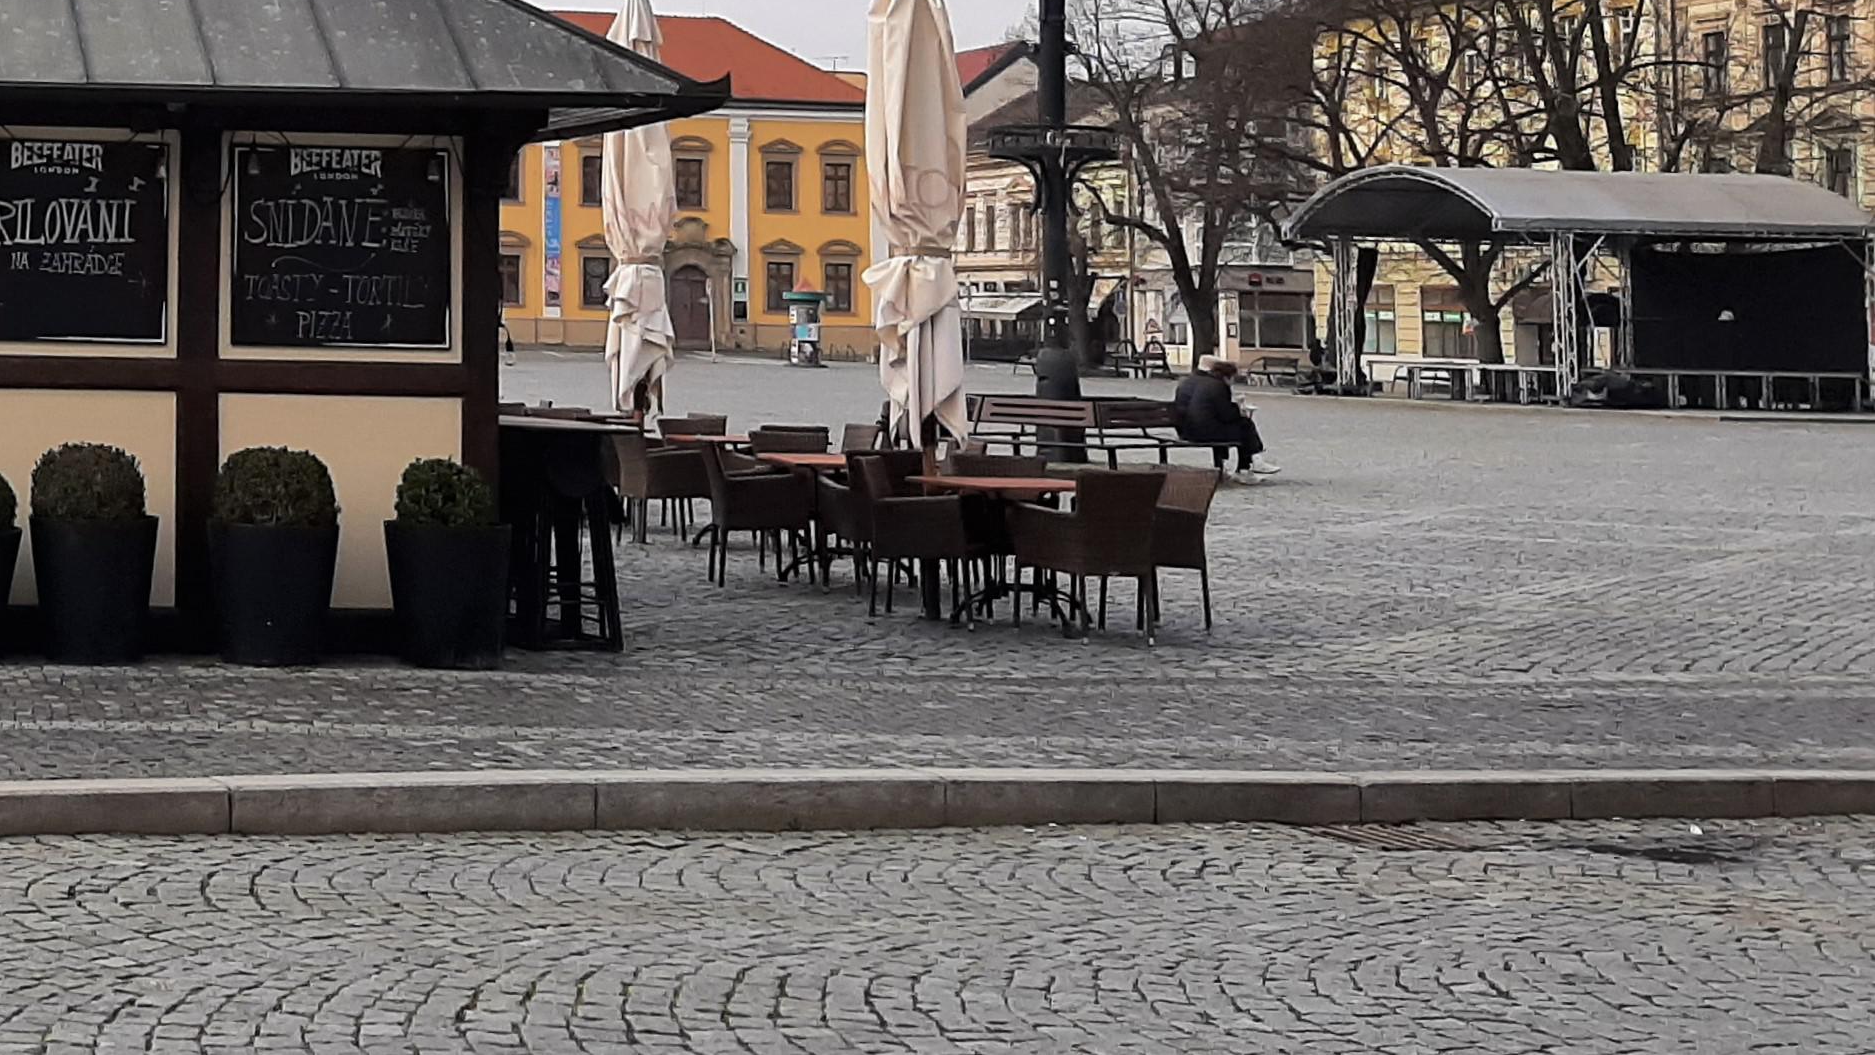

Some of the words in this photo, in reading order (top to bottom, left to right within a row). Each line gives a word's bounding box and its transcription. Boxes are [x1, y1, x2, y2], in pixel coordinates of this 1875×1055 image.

[11, 141, 103, 172] BEEFEATER
[290, 148, 382, 178] BEEFEATER
[10, 251, 30, 270] NA
[295, 310, 354, 340] PIZZA
